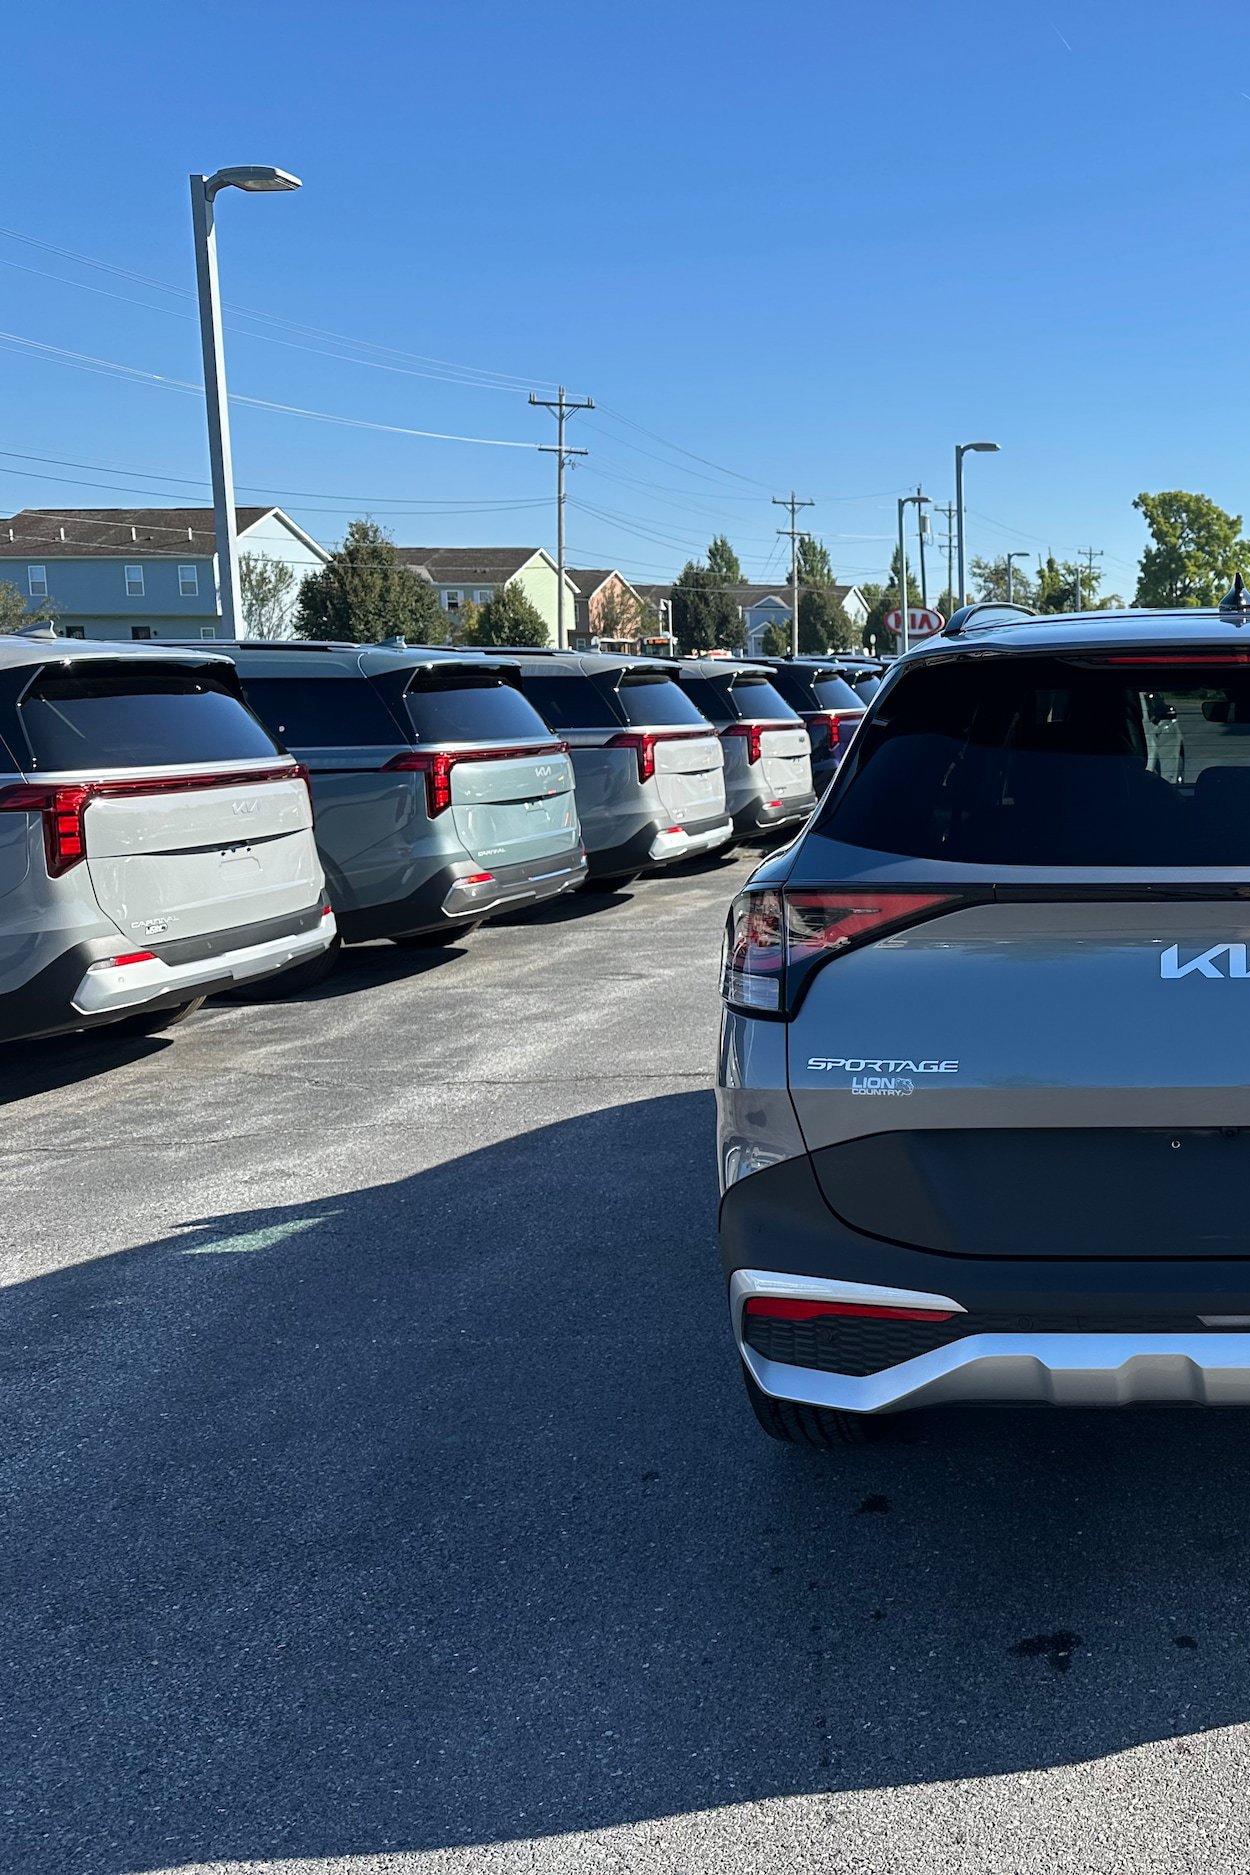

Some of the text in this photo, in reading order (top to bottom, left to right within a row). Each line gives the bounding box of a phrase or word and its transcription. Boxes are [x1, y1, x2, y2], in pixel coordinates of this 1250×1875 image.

[807, 1057, 959, 1073] SPORTAGE
[852, 1077, 895, 1089] LION
[852, 1088, 902, 1096] COUNTRY
